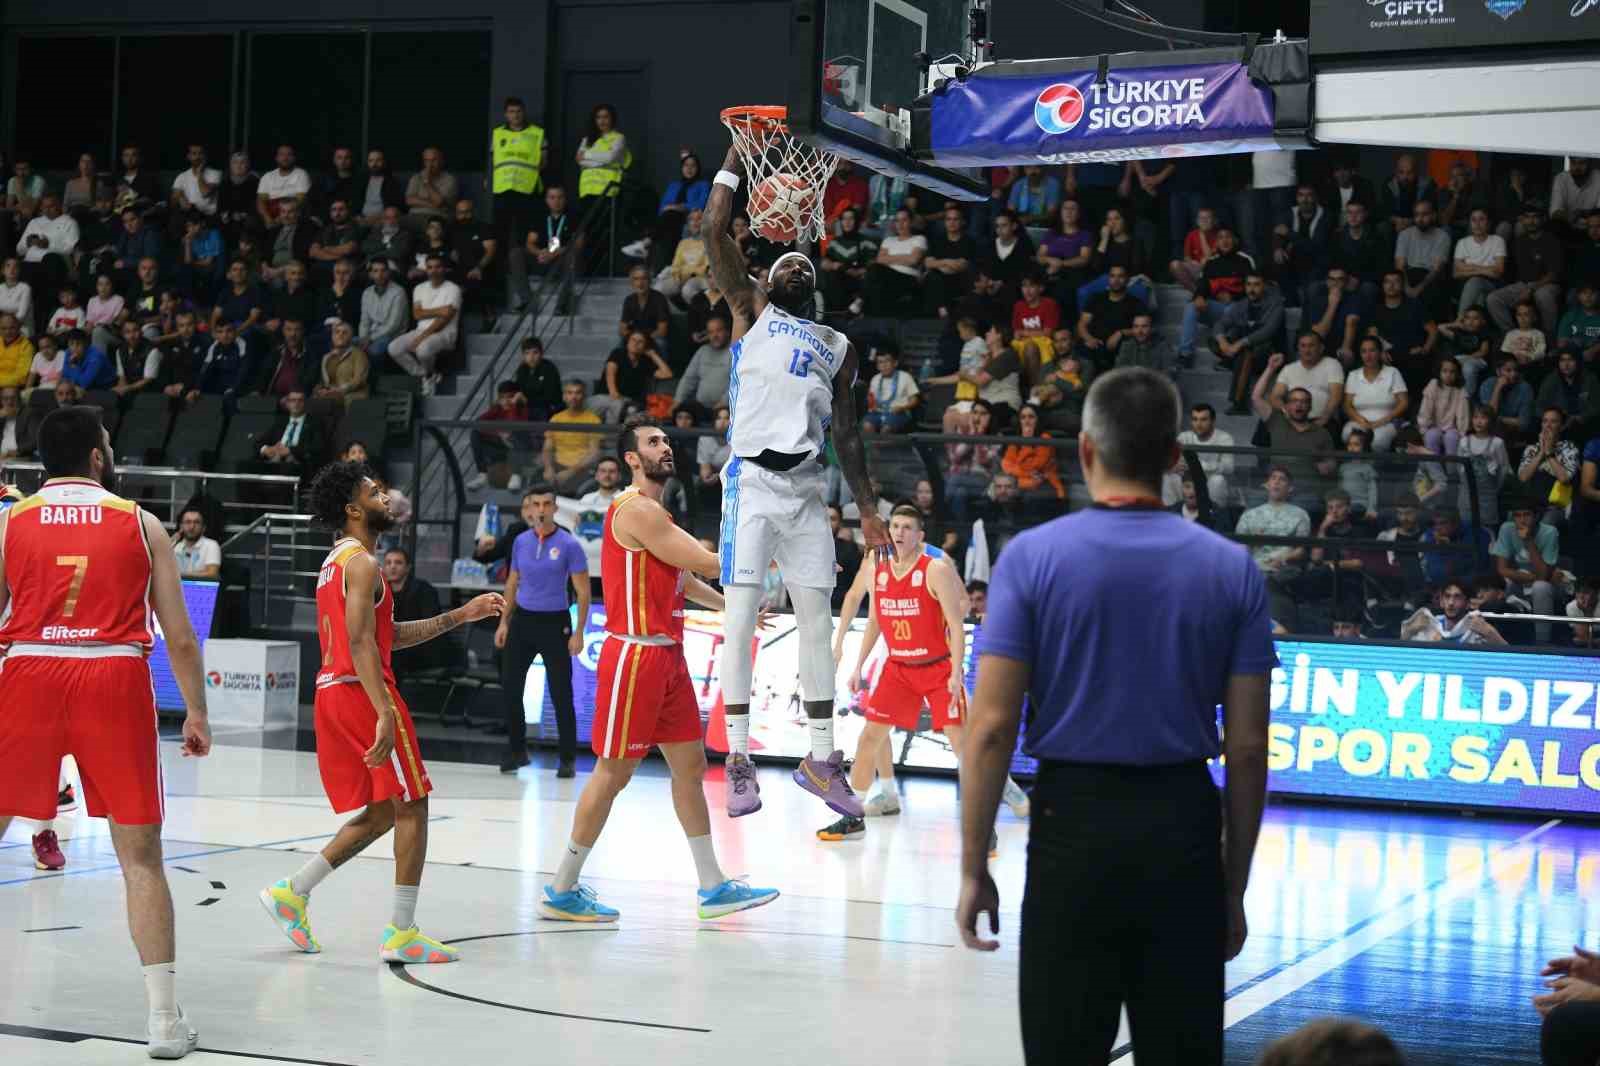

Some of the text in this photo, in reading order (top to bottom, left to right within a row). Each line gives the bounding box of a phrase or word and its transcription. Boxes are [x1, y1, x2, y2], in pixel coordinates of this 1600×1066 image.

[1089, 78, 1204, 105] TÜRKİYE
[1088, 102, 1205, 129] SİGORTA
[56, 555, 89, 617] 7
[891, 619, 912, 641] 20
[1376, 670, 1600, 730] YILDIZ
